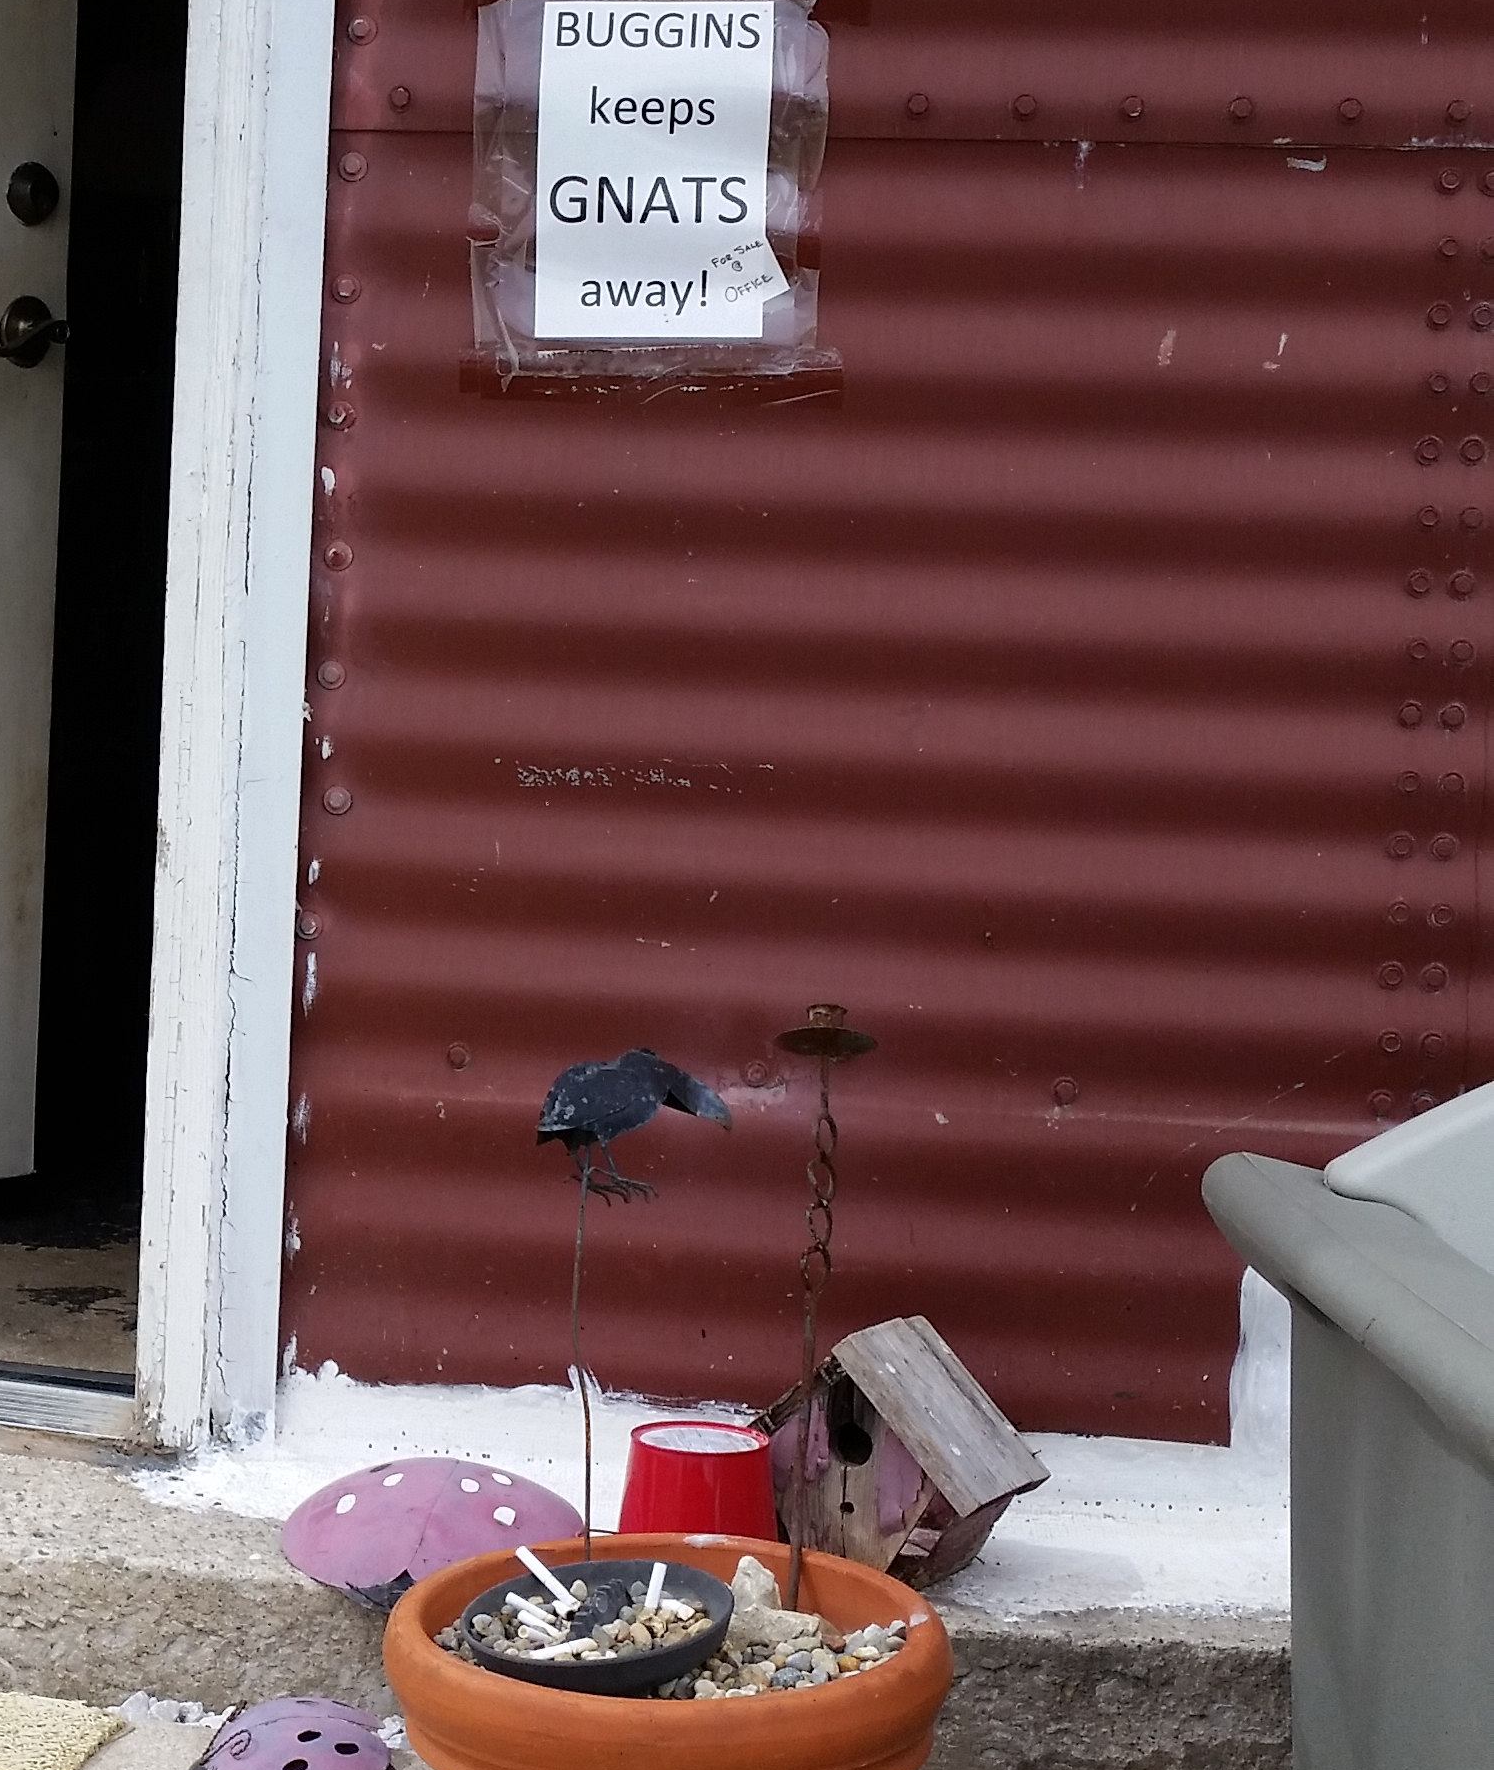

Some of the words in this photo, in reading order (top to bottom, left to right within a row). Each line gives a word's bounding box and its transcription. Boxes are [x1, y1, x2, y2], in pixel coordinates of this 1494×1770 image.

[556, 11, 761, 49] BUGGINS
[590, 86, 716, 134] keeps
[549, 176, 749, 224] GNATS
[731, 260, 743, 272] @
[581, 270, 708, 315] away!
[725, 274, 774, 303] OFFICE
